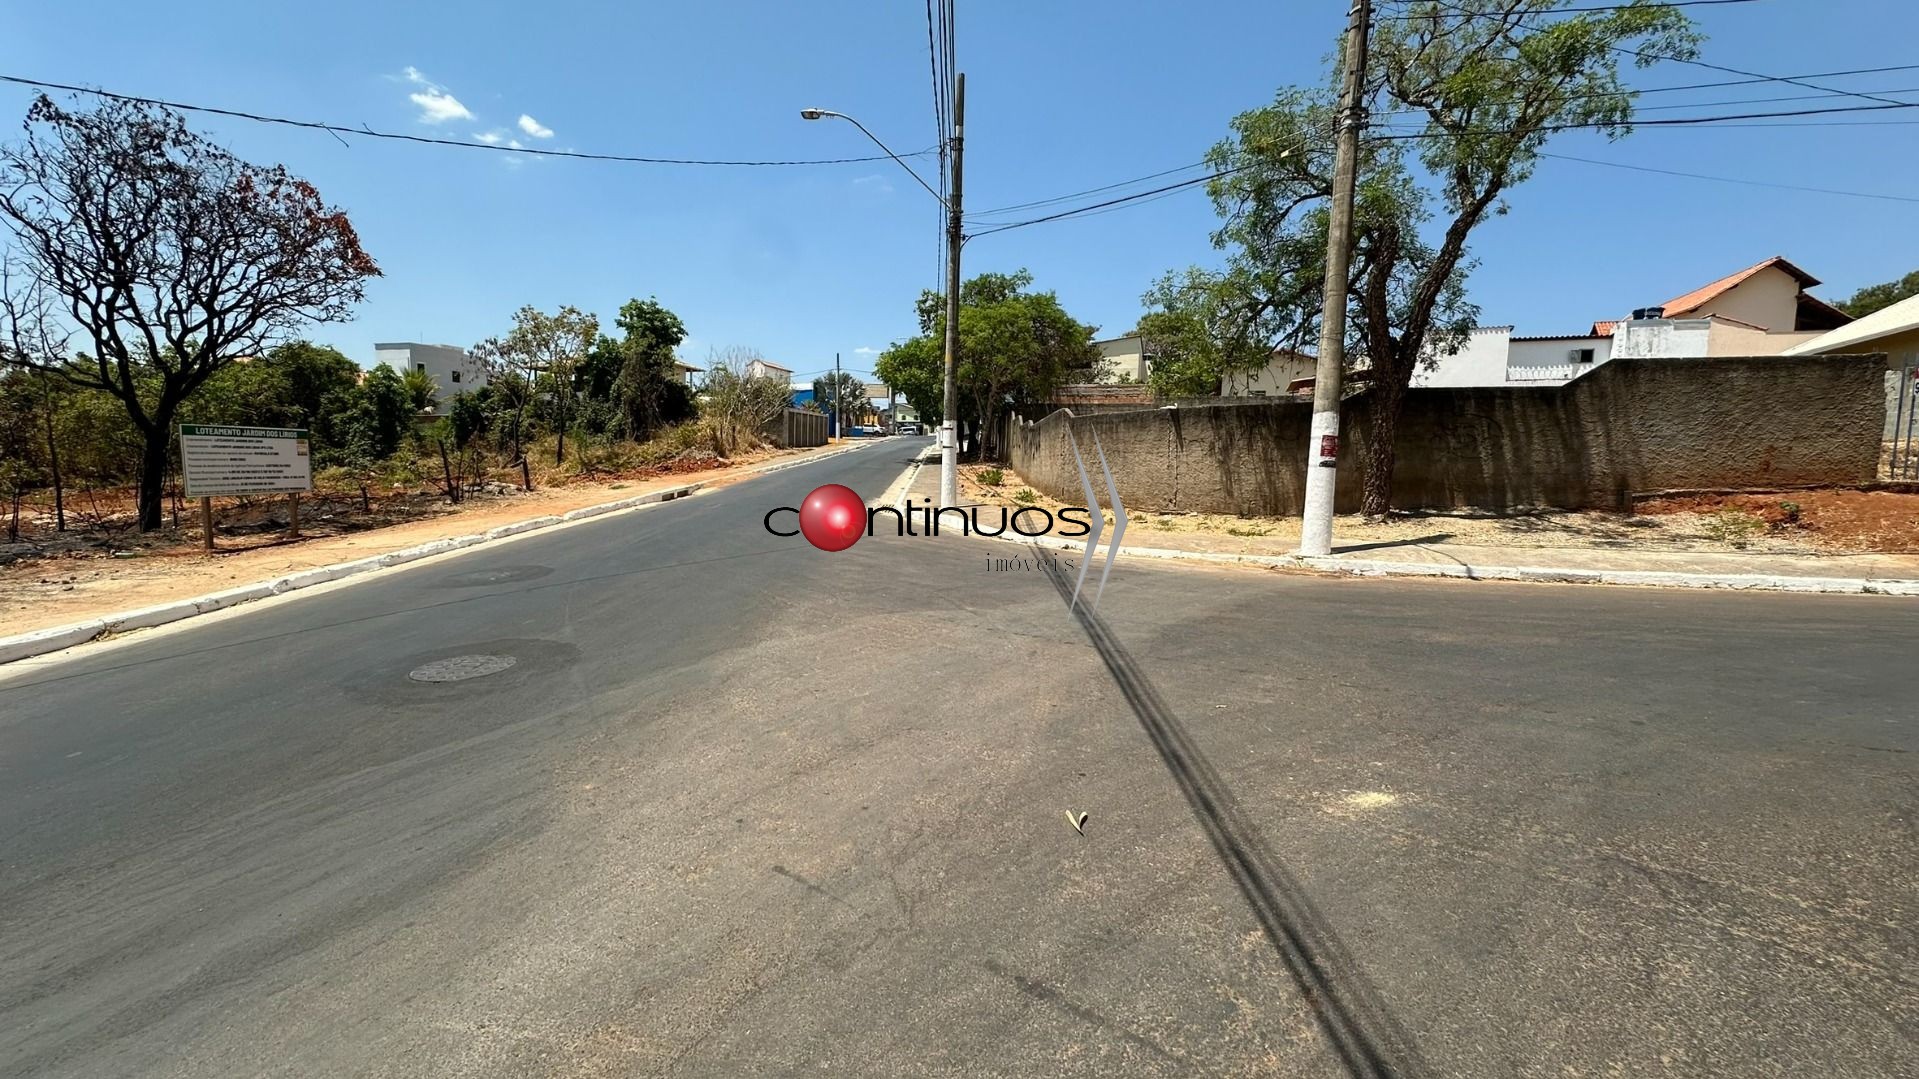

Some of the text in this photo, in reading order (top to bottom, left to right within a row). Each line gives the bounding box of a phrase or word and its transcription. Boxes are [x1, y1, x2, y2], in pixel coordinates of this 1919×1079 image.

[195, 427, 241, 436] LOTEAMENTO
[242, 429, 266, 437] JARDIM
[266, 430, 279, 438] DOS
